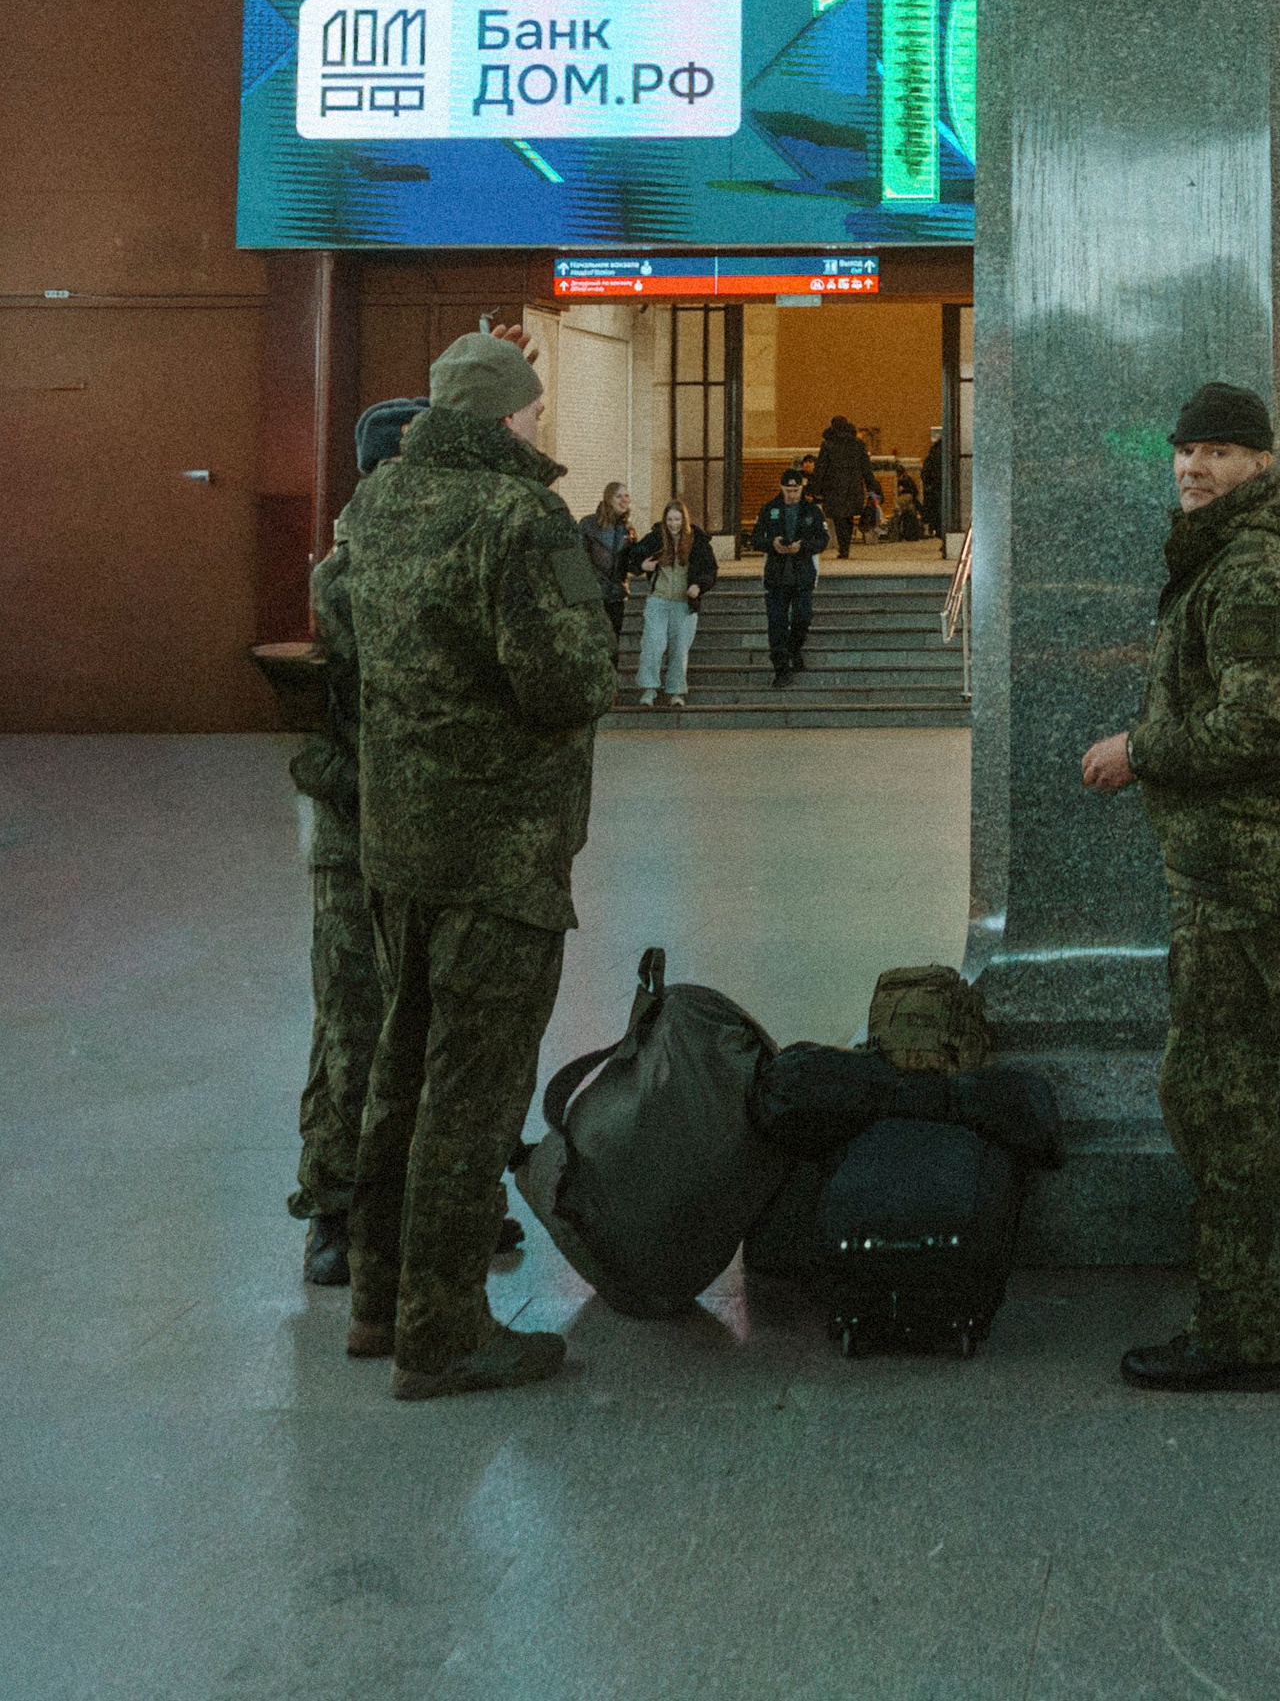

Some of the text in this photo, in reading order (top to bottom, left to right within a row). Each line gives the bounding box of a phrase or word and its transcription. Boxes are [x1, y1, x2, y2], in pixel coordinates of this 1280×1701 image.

[321, 9, 426, 67] ДОМ
[477, 9, 612, 51] Банк
[321, 86, 425, 117] РФ
[472, 61, 715, 116] ДОМ.РФ
